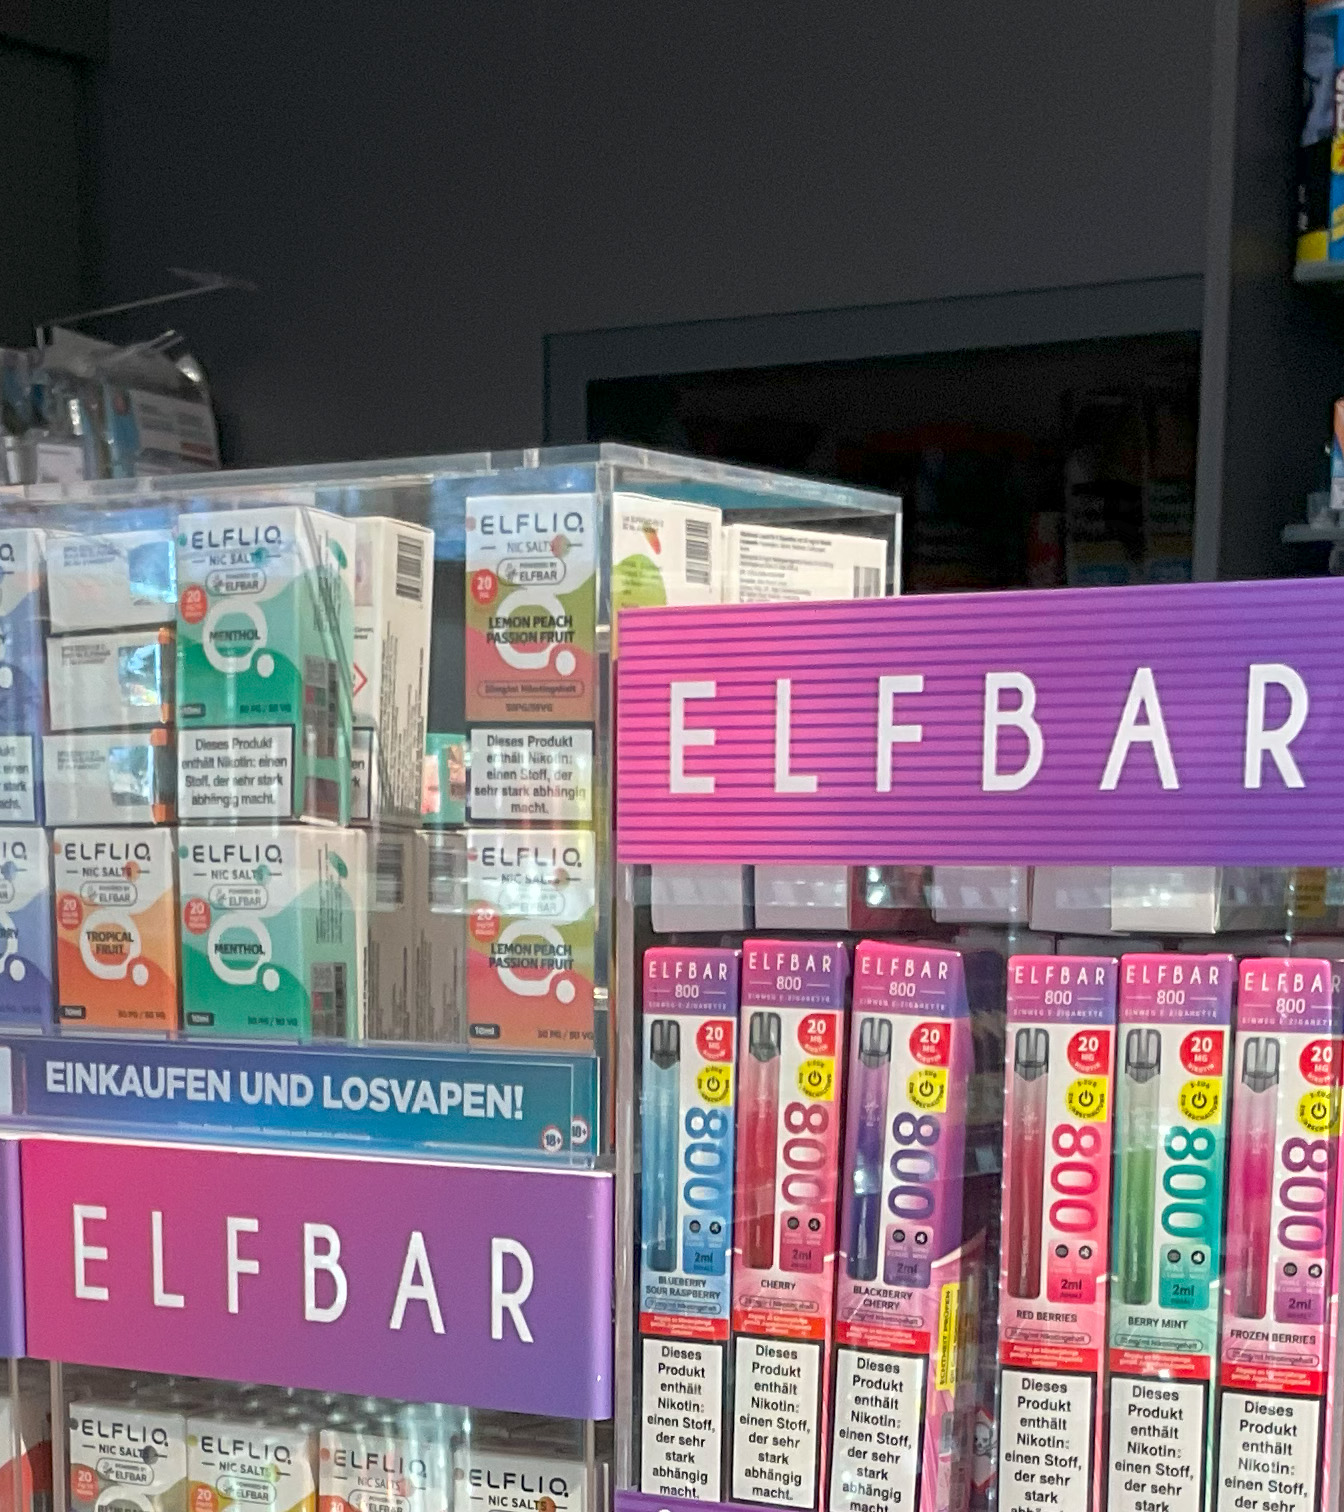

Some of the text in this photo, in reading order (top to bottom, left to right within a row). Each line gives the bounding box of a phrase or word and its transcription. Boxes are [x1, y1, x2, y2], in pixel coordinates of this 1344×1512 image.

[489, 615, 573, 629] LEMON PEACH
[209, 629, 261, 642] MENTHOL
[486, 630, 574, 644] PASSION FRUIT
[669, 664, 1311, 793] ELFBAR
[86, 931, 134, 944] TROPICAL
[96, 944, 125, 955] FRUIT
[45, 1061, 524, 1121] EINKAUFEN UND LOSVAPEN!
[72, 1203, 535, 1344] ELFBAR
[761, 1279, 796, 1291] CHERRY
[863, 1298, 900, 1311] CHERRY
[1128, 1316, 1188, 1330] BERRY MINT
[1230, 1329, 1316, 1345] FROZEN BERRIES
[469, 1468, 569, 1498] ELFLIQ
[488, 1495, 547, 1512] NIC SALTS
